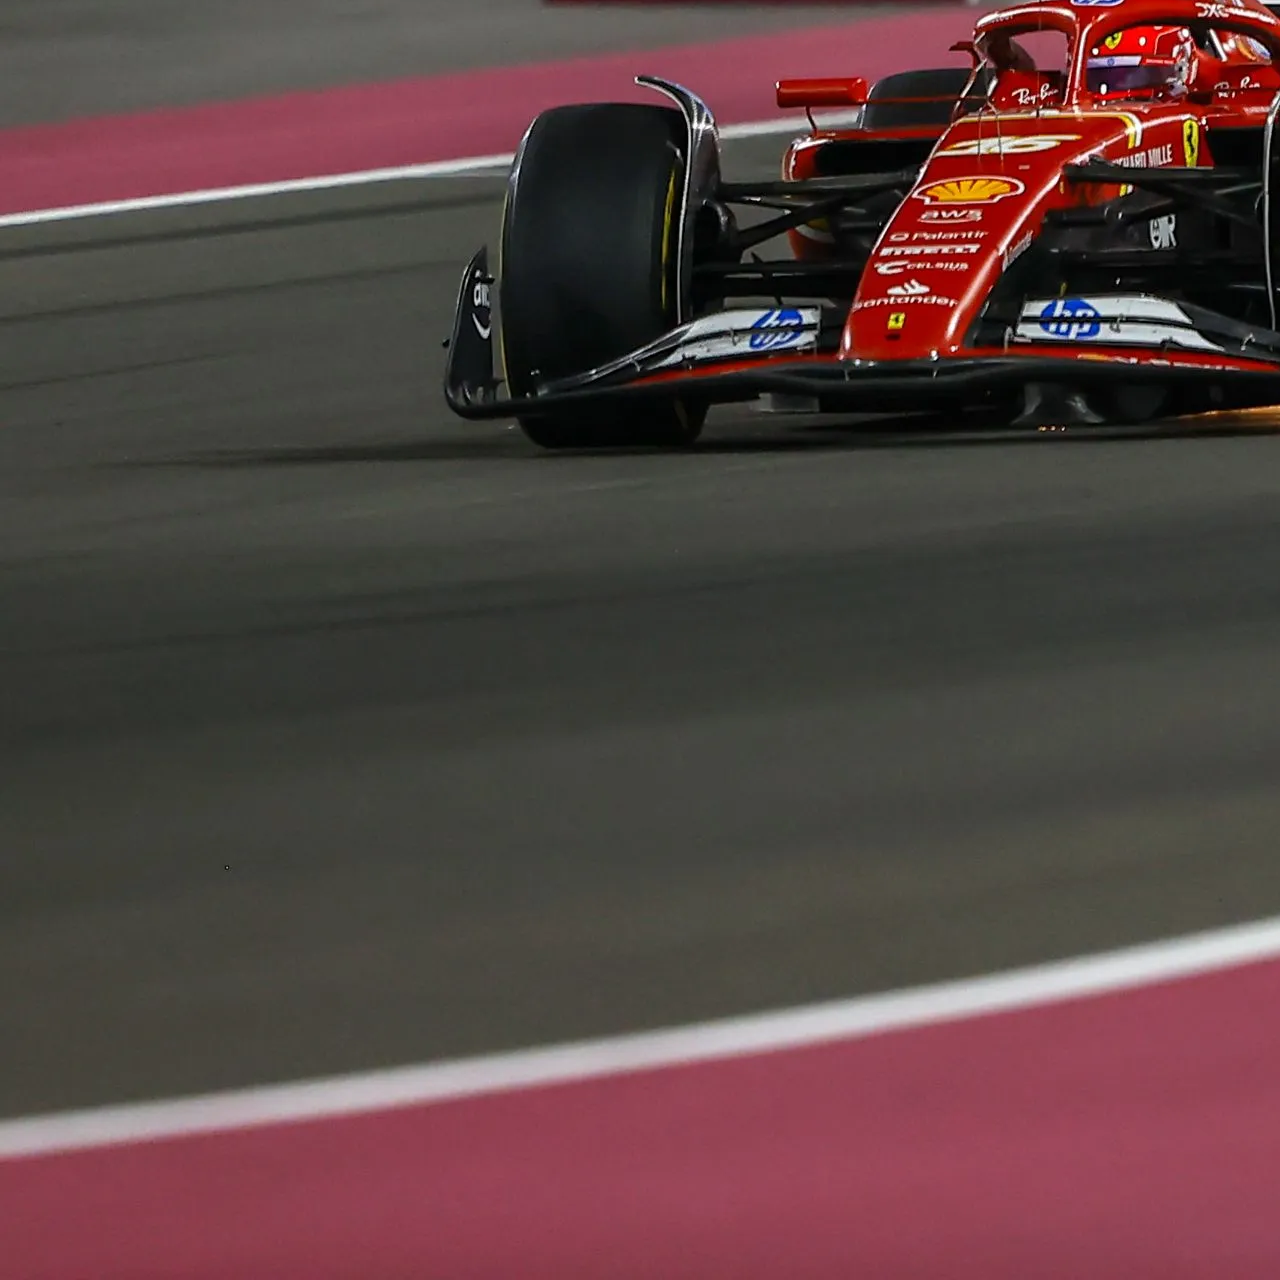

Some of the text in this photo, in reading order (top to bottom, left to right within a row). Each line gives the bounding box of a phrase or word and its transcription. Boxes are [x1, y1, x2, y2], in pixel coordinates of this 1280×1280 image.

[918, 209, 983, 223] aws
[912, 230, 989, 240] Palantir
[880, 243, 981, 257] PIRELLI
[1041, 297, 1100, 340] hp
[750, 307, 804, 350] hp
